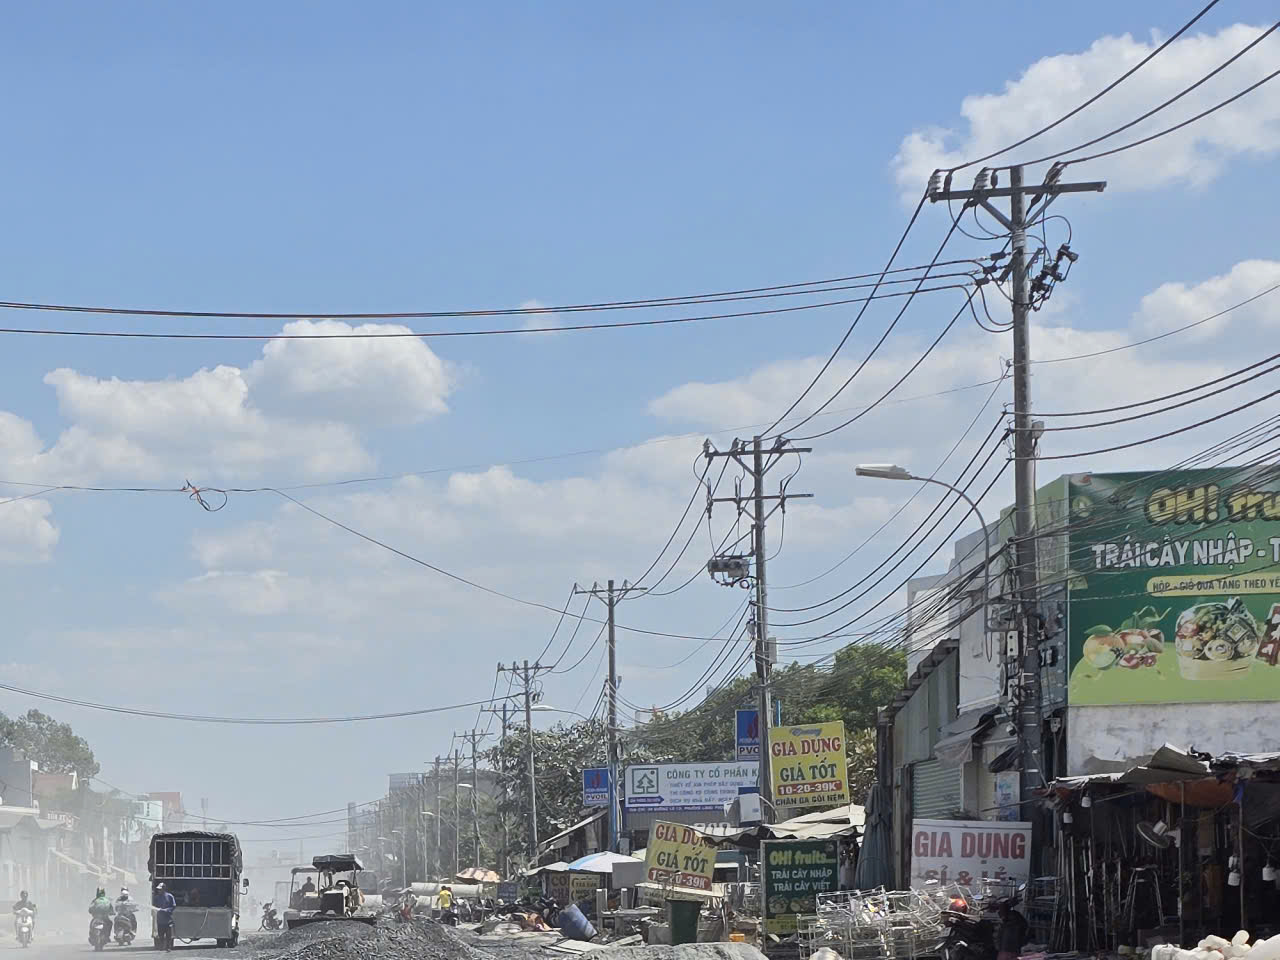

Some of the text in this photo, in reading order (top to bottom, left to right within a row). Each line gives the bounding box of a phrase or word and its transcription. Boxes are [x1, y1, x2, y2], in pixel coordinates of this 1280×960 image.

[1148, 485, 1219, 524] OH!
[1092, 535, 1141, 568] TRÁI
[1145, 534, 1190, 567] CÂY
[1193, 531, 1254, 570] NHẬP
[1245, 578, 1266, 589] THEO
[739, 746, 760, 754] PVO
[772, 737, 841, 757] GIA DỤNG
[667, 768, 690, 779] CÔNG
[695, 770, 705, 779] TY
[780, 757, 836, 782] GIÁ TỐT
[656, 824, 677, 842] GIA
[914, 831, 1025, 864] GIA DỤNG
[657, 850, 708, 873] GIÁ TỐT
[771, 868, 790, 879] TRÁI
[773, 881, 792, 892] TRÁI
